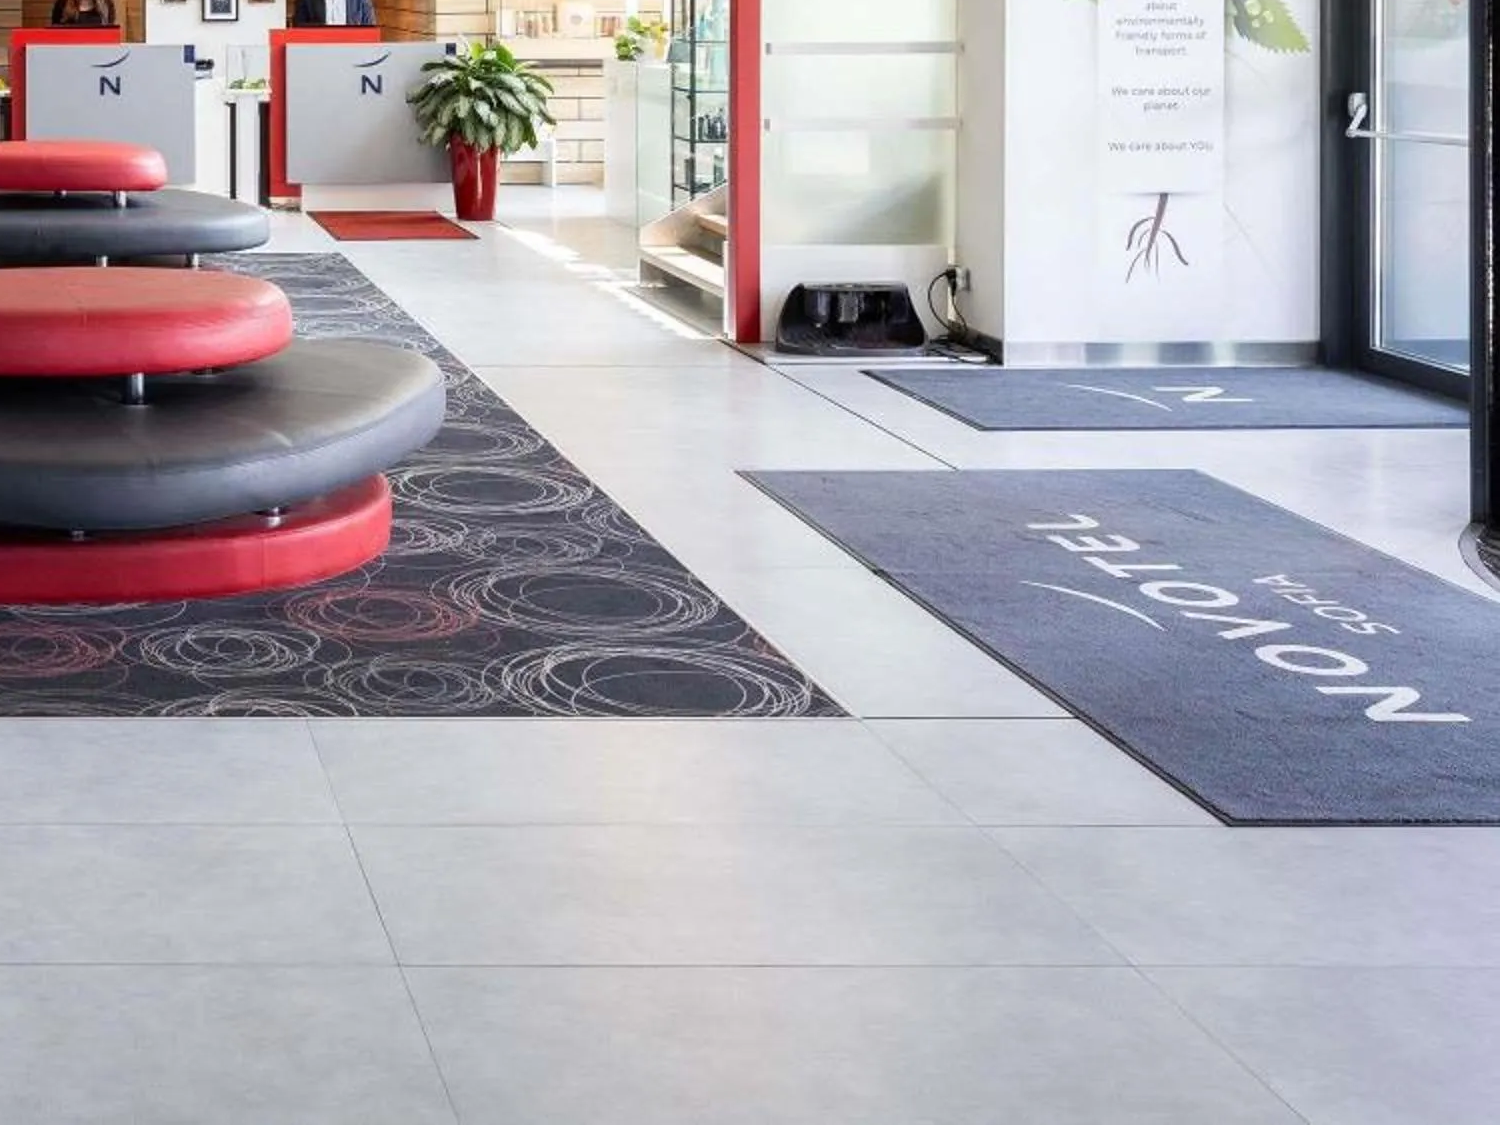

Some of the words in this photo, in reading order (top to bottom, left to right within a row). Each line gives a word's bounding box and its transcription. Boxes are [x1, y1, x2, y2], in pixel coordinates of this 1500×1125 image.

[1146, 1, 1178, 12] about
[99, 75, 121, 96] N
[361, 74, 382, 95] N
[1111, 85, 1130, 97] We
[1131, 87, 1156, 97] care
[1157, 84, 1191, 97] about
[1192, 87, 1212, 97] our
[1108, 140, 1127, 152] We
[1128, 140, 1153, 152] care
[1155, 140, 1188, 152] about
[1252, 574, 1402, 635] SOFIA
[1027, 513, 1473, 723] NOVOTEL
